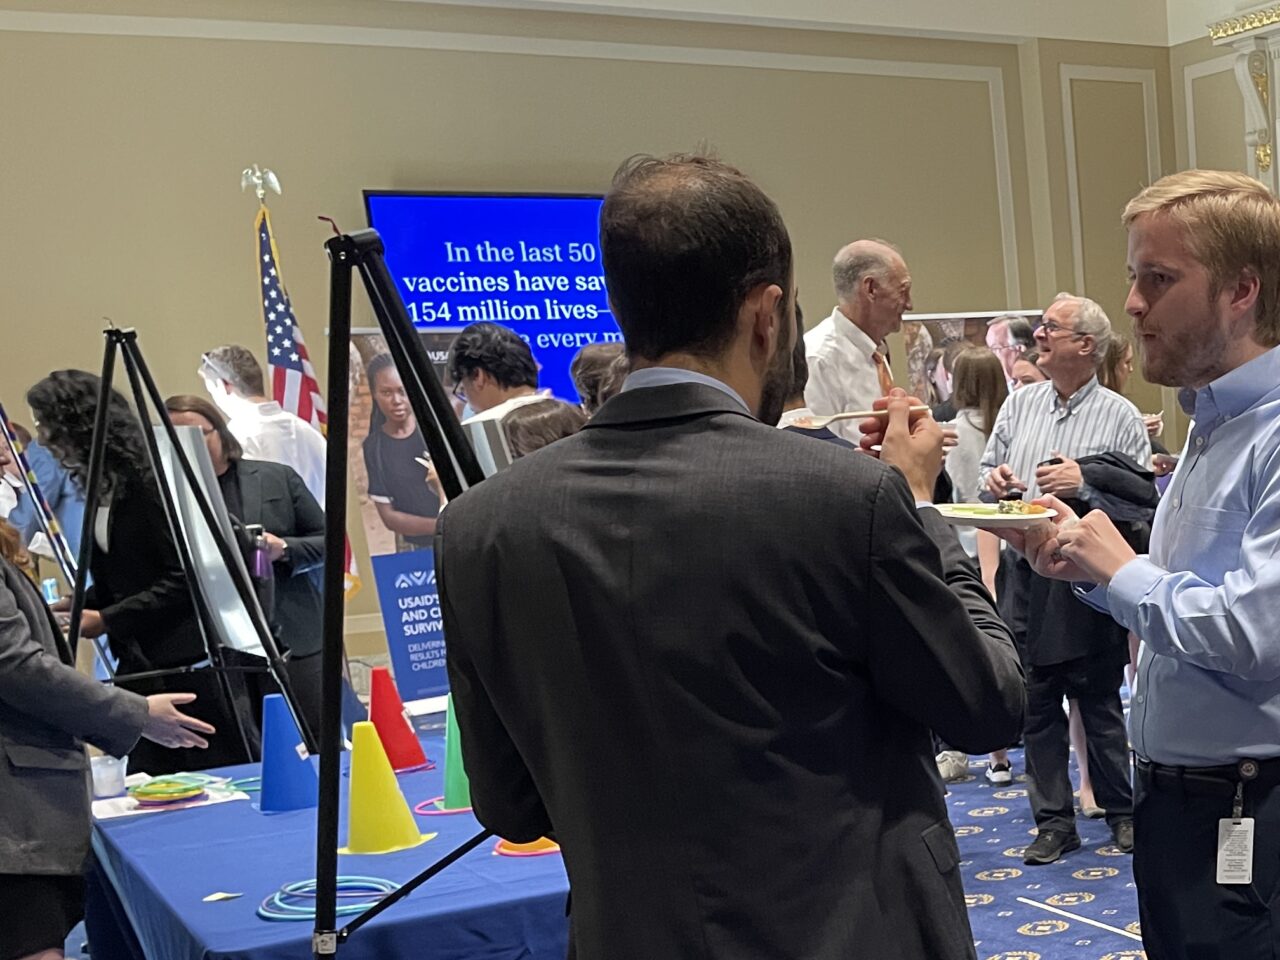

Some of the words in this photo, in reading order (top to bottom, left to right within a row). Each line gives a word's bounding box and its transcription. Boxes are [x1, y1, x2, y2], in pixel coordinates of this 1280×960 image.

[444, 241, 471, 262] In
[476, 240, 515, 262] the
[519, 240, 563, 262] last
[568, 242, 596, 262] 50
[402, 271, 510, 292] vaccines
[513, 269, 570, 291] have
[407, 301, 452, 322] 154
[457, 299, 541, 321] million
[536, 331, 598, 348] every
[402, 608, 428, 623] AND
